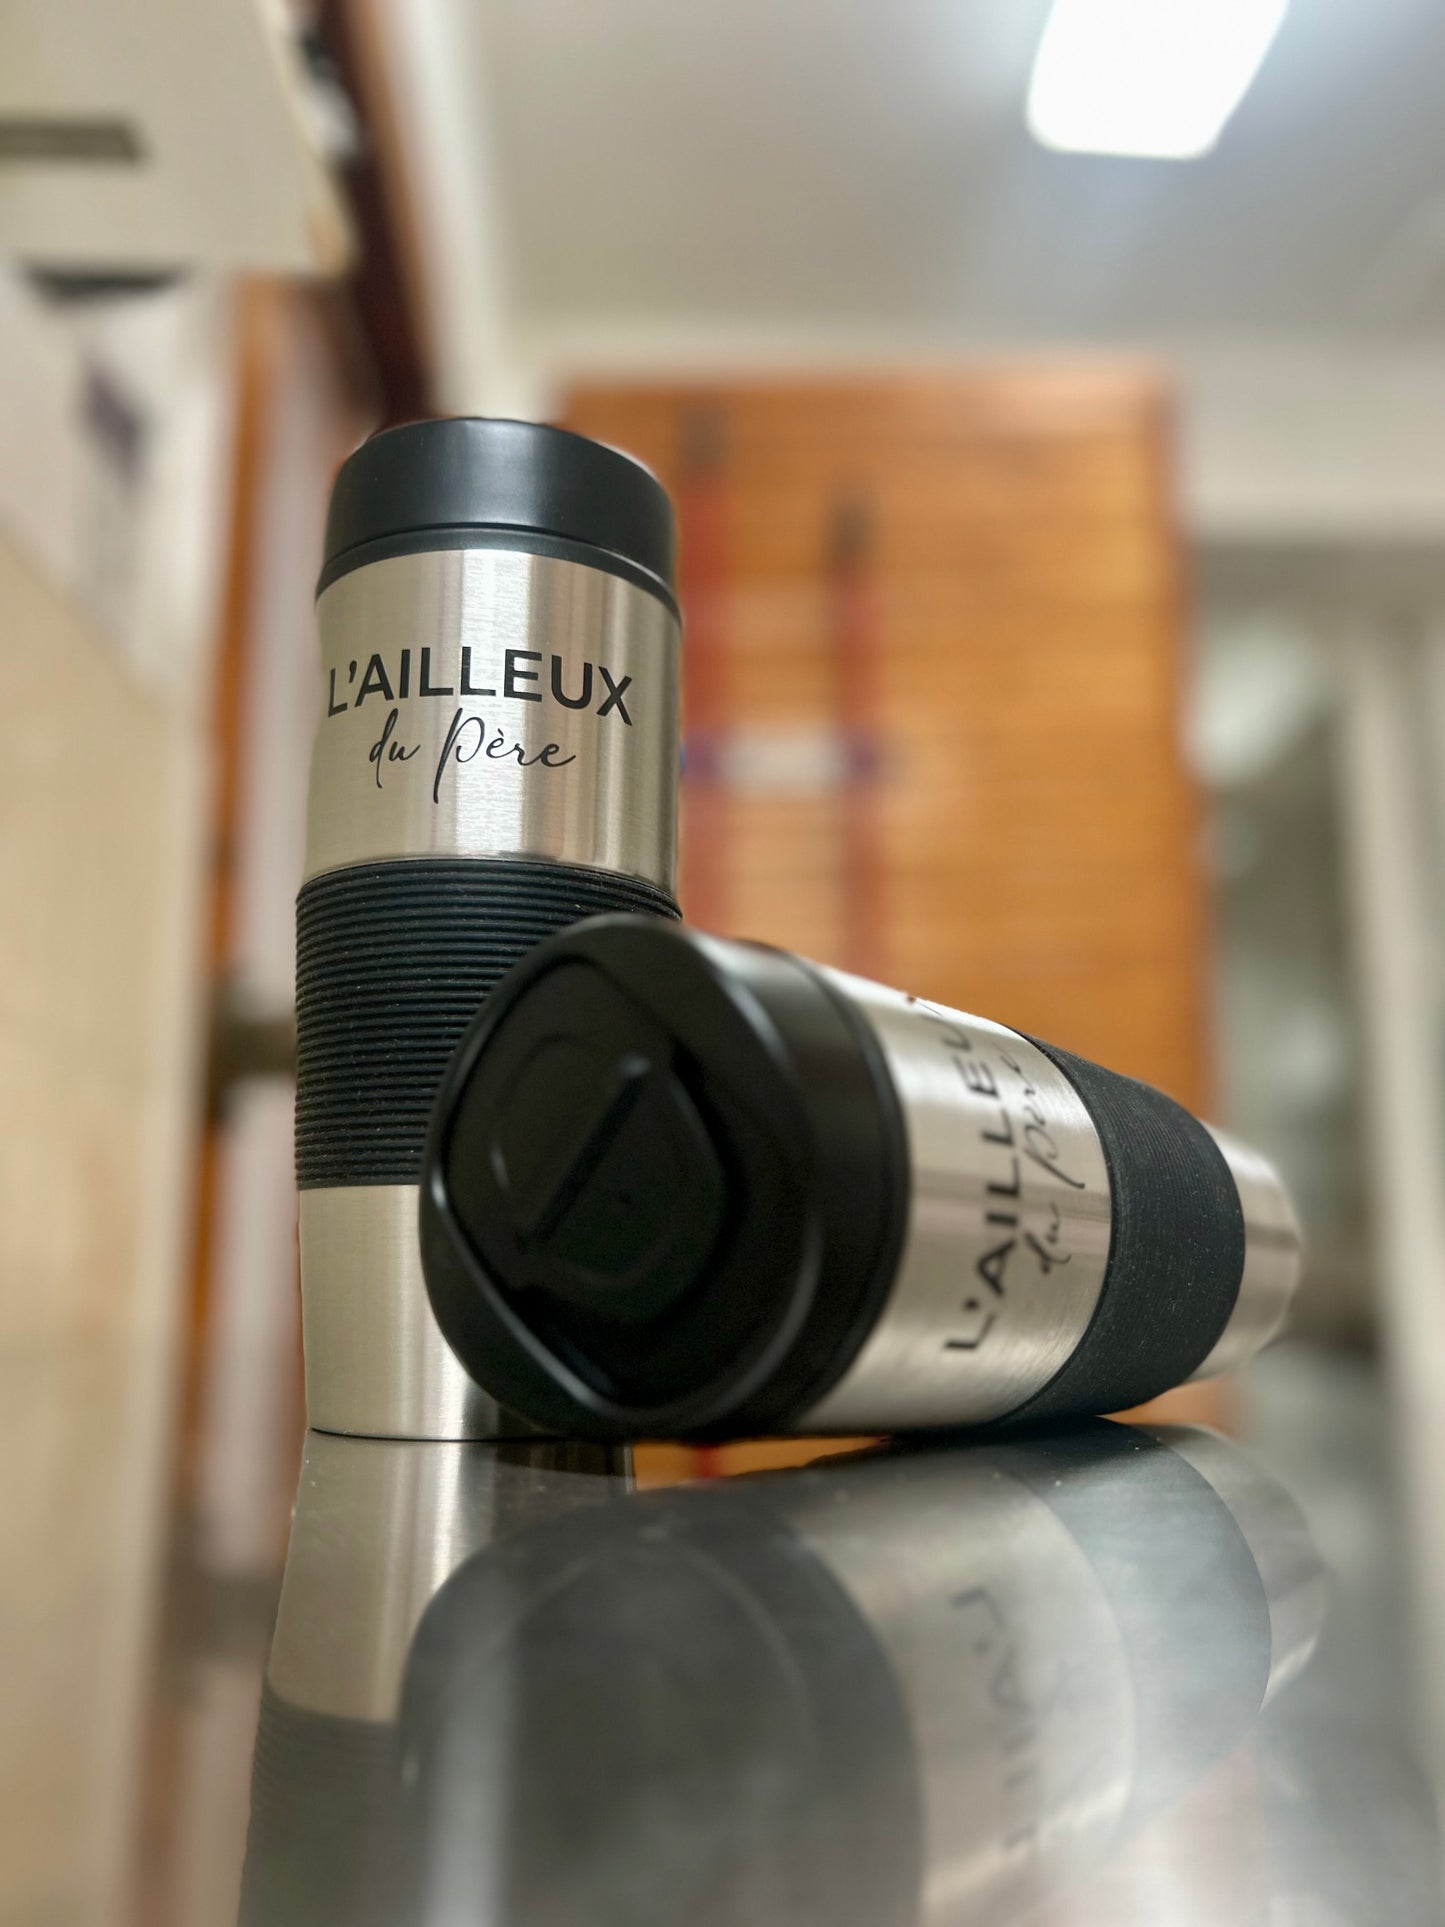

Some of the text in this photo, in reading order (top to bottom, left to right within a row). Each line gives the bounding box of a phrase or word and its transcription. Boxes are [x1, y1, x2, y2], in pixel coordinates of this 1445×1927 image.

[328, 646, 633, 726] L'AILLEUX
[369, 707, 577, 804] du Père
[1023, 1202, 1072, 1276] du
